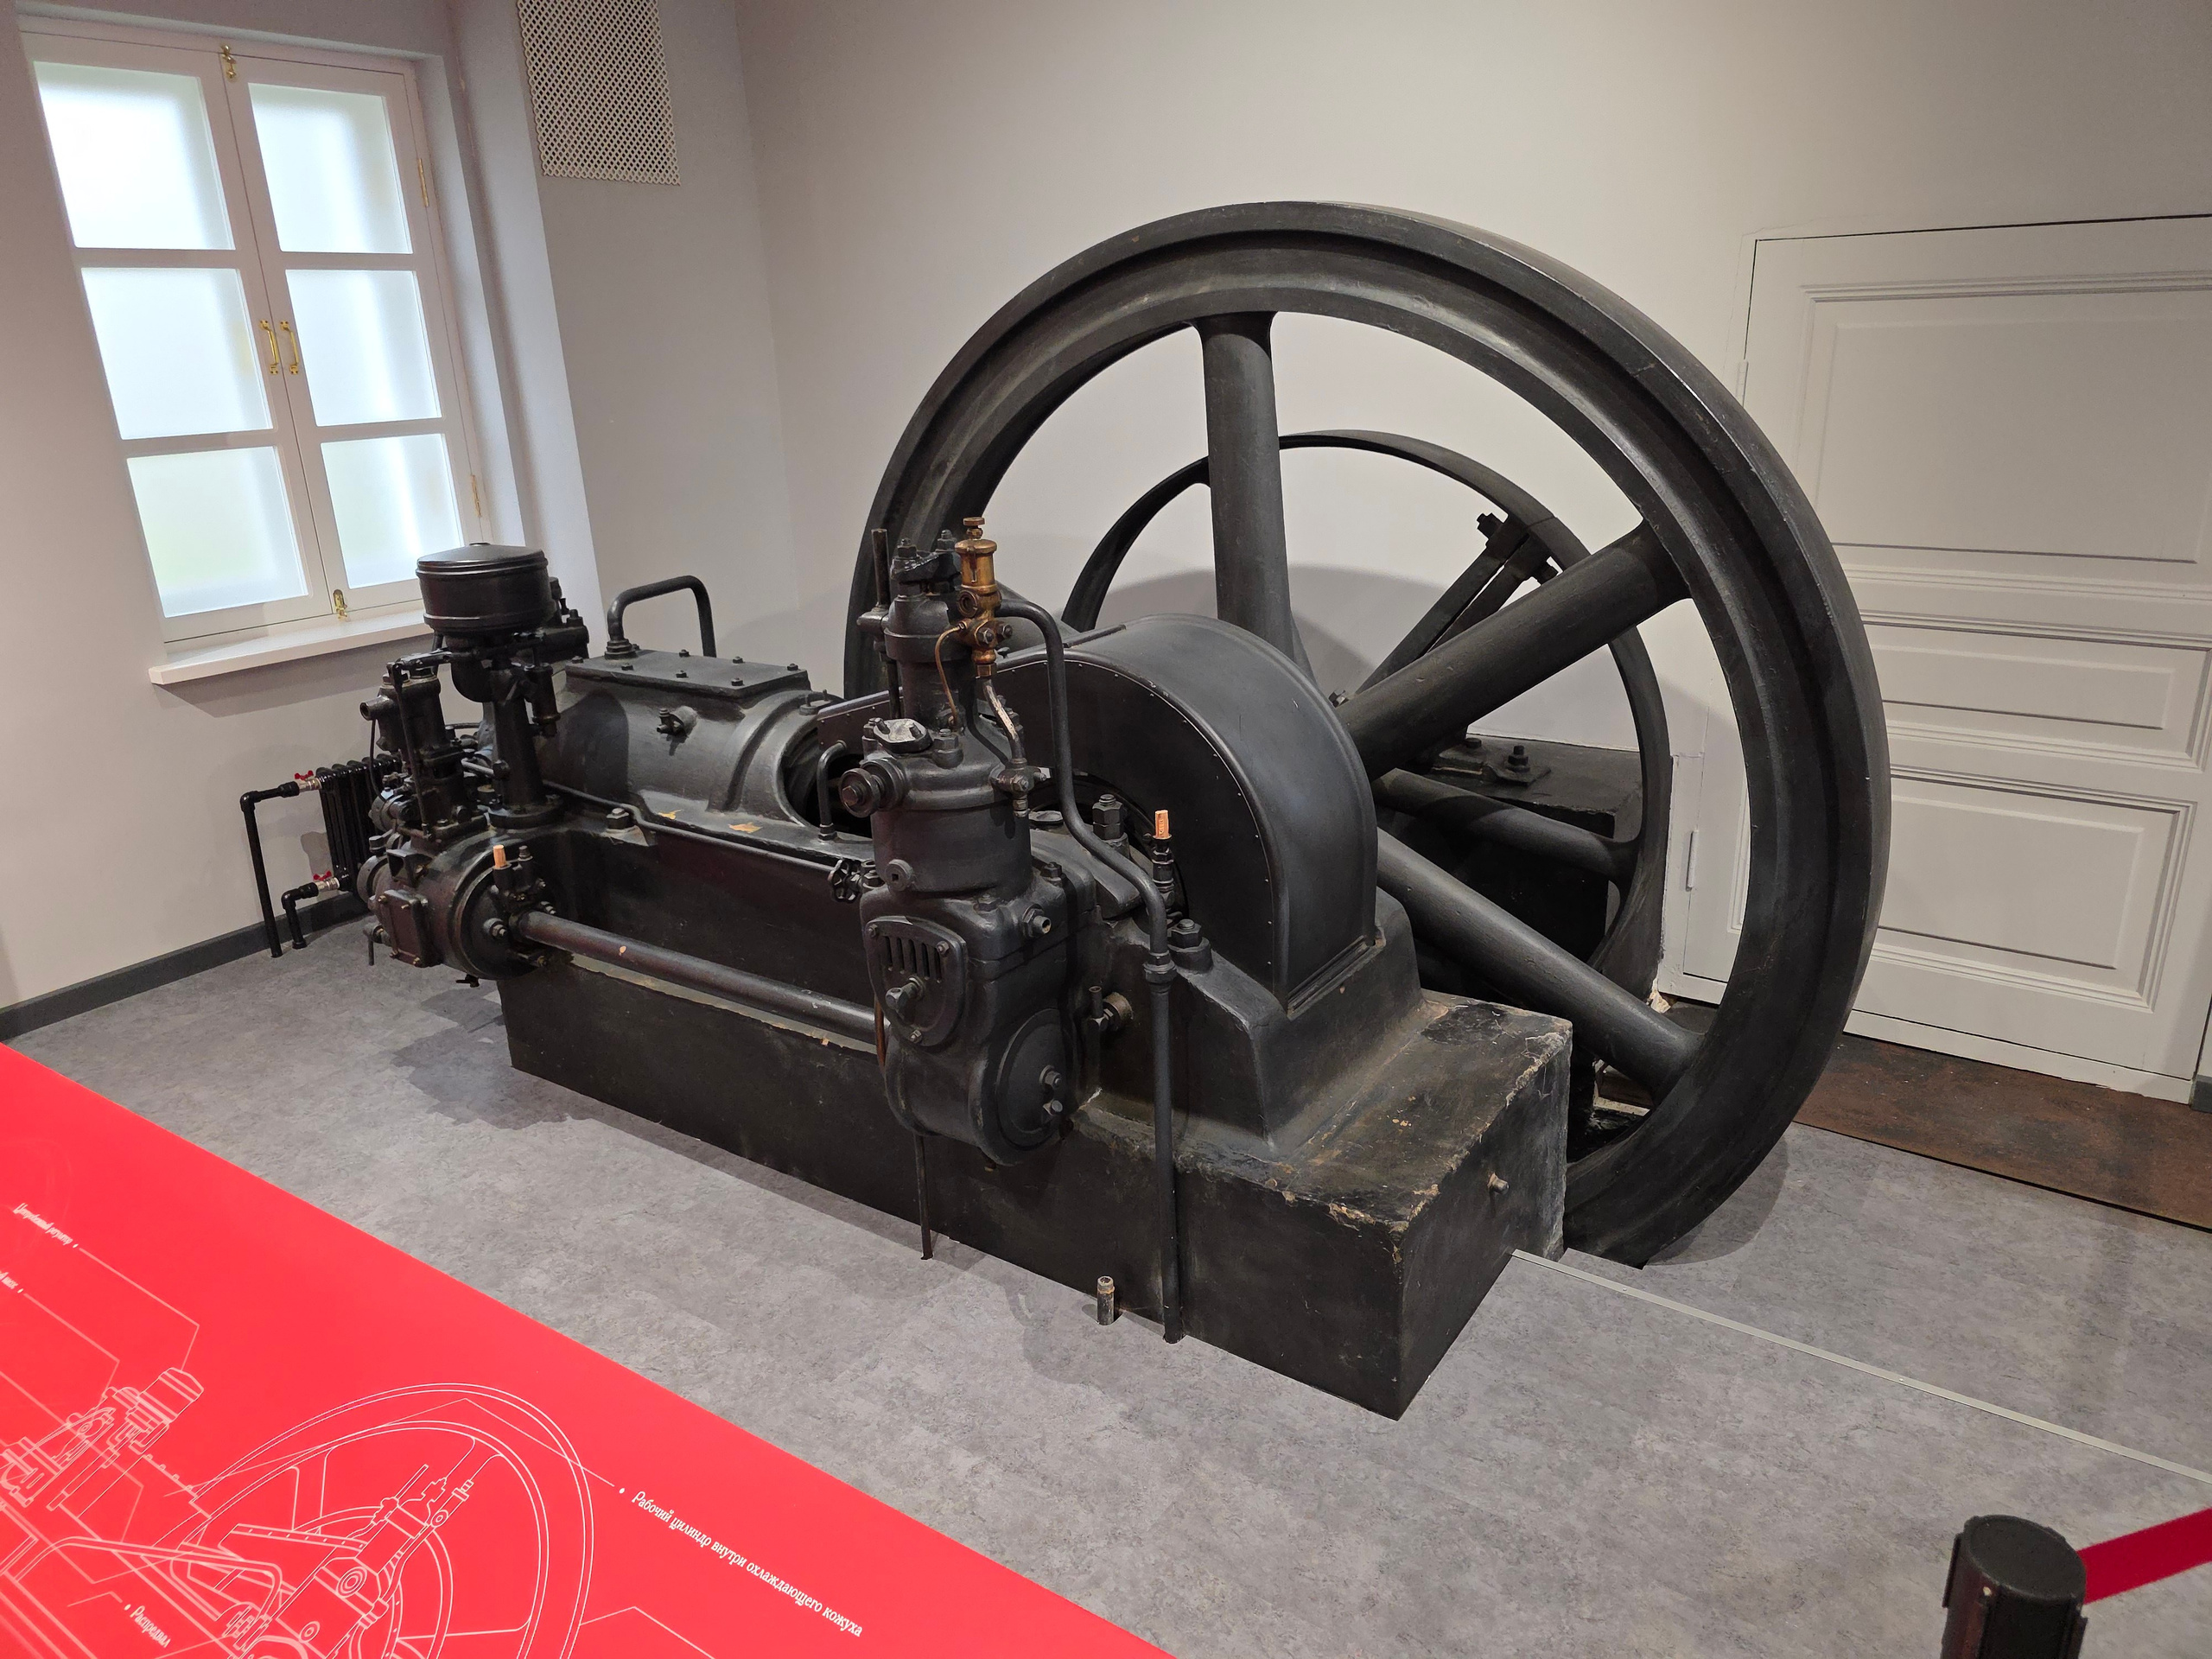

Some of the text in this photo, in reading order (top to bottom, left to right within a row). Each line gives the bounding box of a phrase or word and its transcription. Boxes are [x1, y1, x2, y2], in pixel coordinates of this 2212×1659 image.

[631, 1491, 863, 1637] Рабочий цилиндр внутри охлаждающего кожуха
